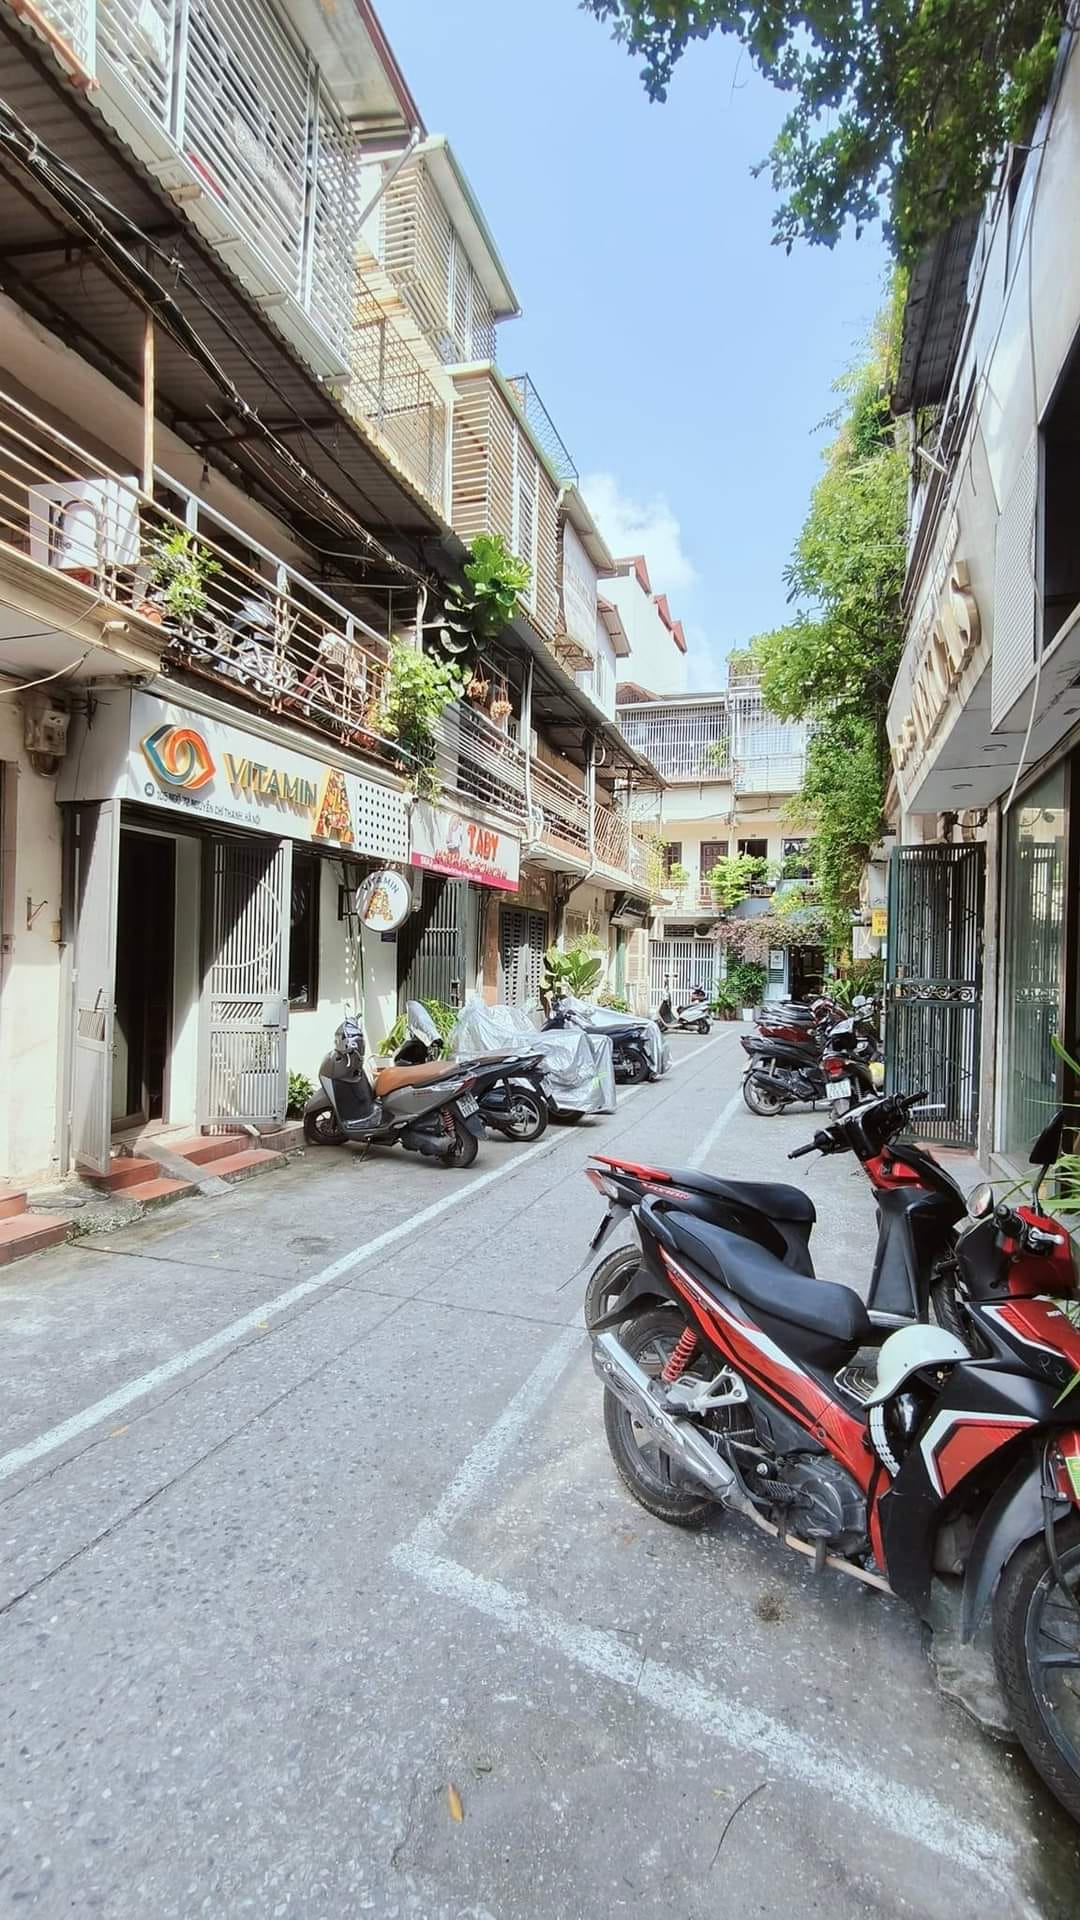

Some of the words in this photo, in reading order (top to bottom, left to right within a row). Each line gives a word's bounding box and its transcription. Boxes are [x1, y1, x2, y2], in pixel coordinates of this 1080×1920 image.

[222, 752, 317, 809] VITAMIN
[312, 768, 355, 844] A
[467, 823, 499, 861] TABY
